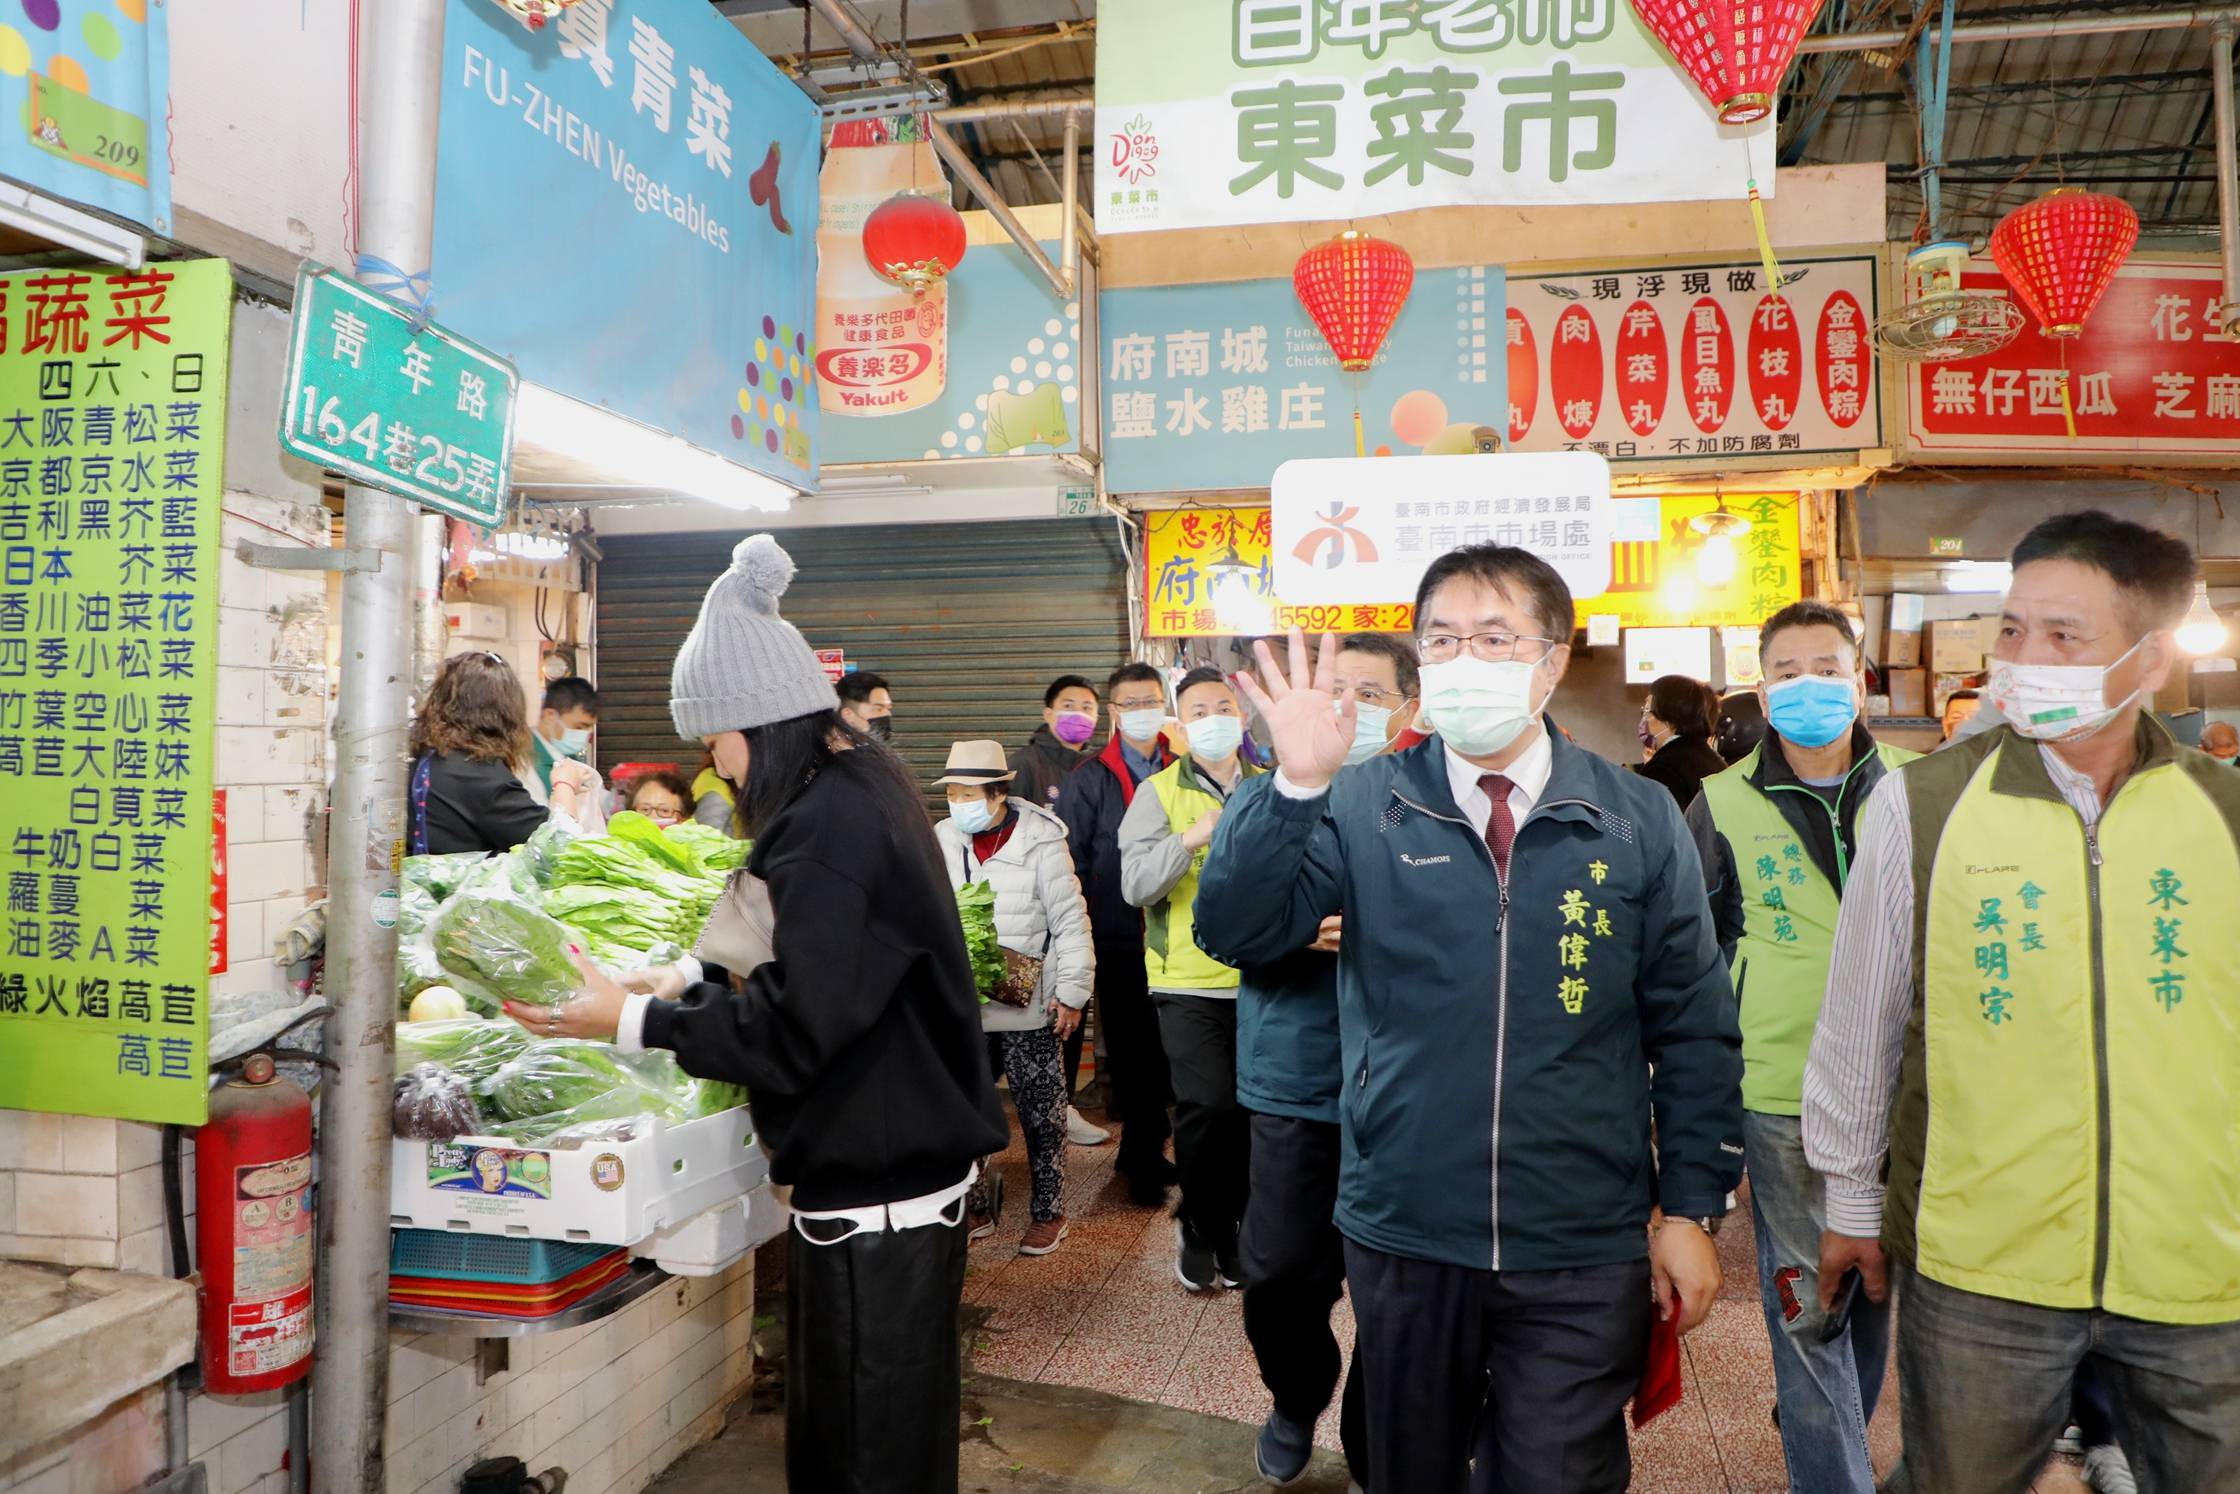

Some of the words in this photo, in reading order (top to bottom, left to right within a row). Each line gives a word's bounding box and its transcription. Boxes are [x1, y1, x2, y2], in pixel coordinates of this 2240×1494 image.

[94, 134, 140, 167] 209
[464, 44, 600, 169] FU-ZHEN
[607, 140, 730, 253] Vegetables
[1229, 61, 1625, 199] 東菜市
[1592, 269, 1756, 300] 現浮現做
[0, 267, 174, 355] 蔬菜
[843, 325, 906, 343] 健康食品
[331, 309, 488, 421] 青年路
[1109, 325, 1270, 381] 府南城
[1626, 308, 1658, 429] 芹菜丸
[1690, 305, 1725, 425] 虱目魚丸
[1758, 301, 1791, 422] 花枝丸
[840, 388, 909, 407] Yakult
[1109, 382, 1326, 439] 鹽水雞庄
[1931, 366, 2118, 417] 無仔西瓜
[2152, 371, 2240, 419] 芝麻
[1, 402, 202, 449] 大阪青松菜
[302, 384, 498, 504] 164巷25弄
[0, 450, 200, 498] 京都京水菜
[0, 496, 198, 541] 吉利黑芥藍
[1069, 500, 1088, 515] 26
[1394, 495, 1592, 518] 臺南市政府經濟發展局
[1394, 519, 1592, 552] 臺南市市場處
[0, 592, 195, 633] 香川油菜花
[0, 637, 196, 680] 四季小松菜
[0, 690, 193, 736] 竹葉空心菜
[69, 783, 187, 830] 白莧菜
[12, 827, 168, 874] 牛奶白菜
[1415, 855, 1451, 866] CHAMOIS
[1588, 859, 1614, 937] 市長
[2016, 879, 2048, 953] 會長
[6, 918, 161, 968] 油麥A菜
[1557, 889, 1591, 1015] 黃偉哲
[1973, 897, 2013, 1026] 吳明宗
[2146, 867, 2190, 1014] 東菜市
[0, 972, 196, 1025] 綠火焰萵苣
[117, 1033, 193, 1080] 萵苣
[596, 1161, 617, 1174] USA
